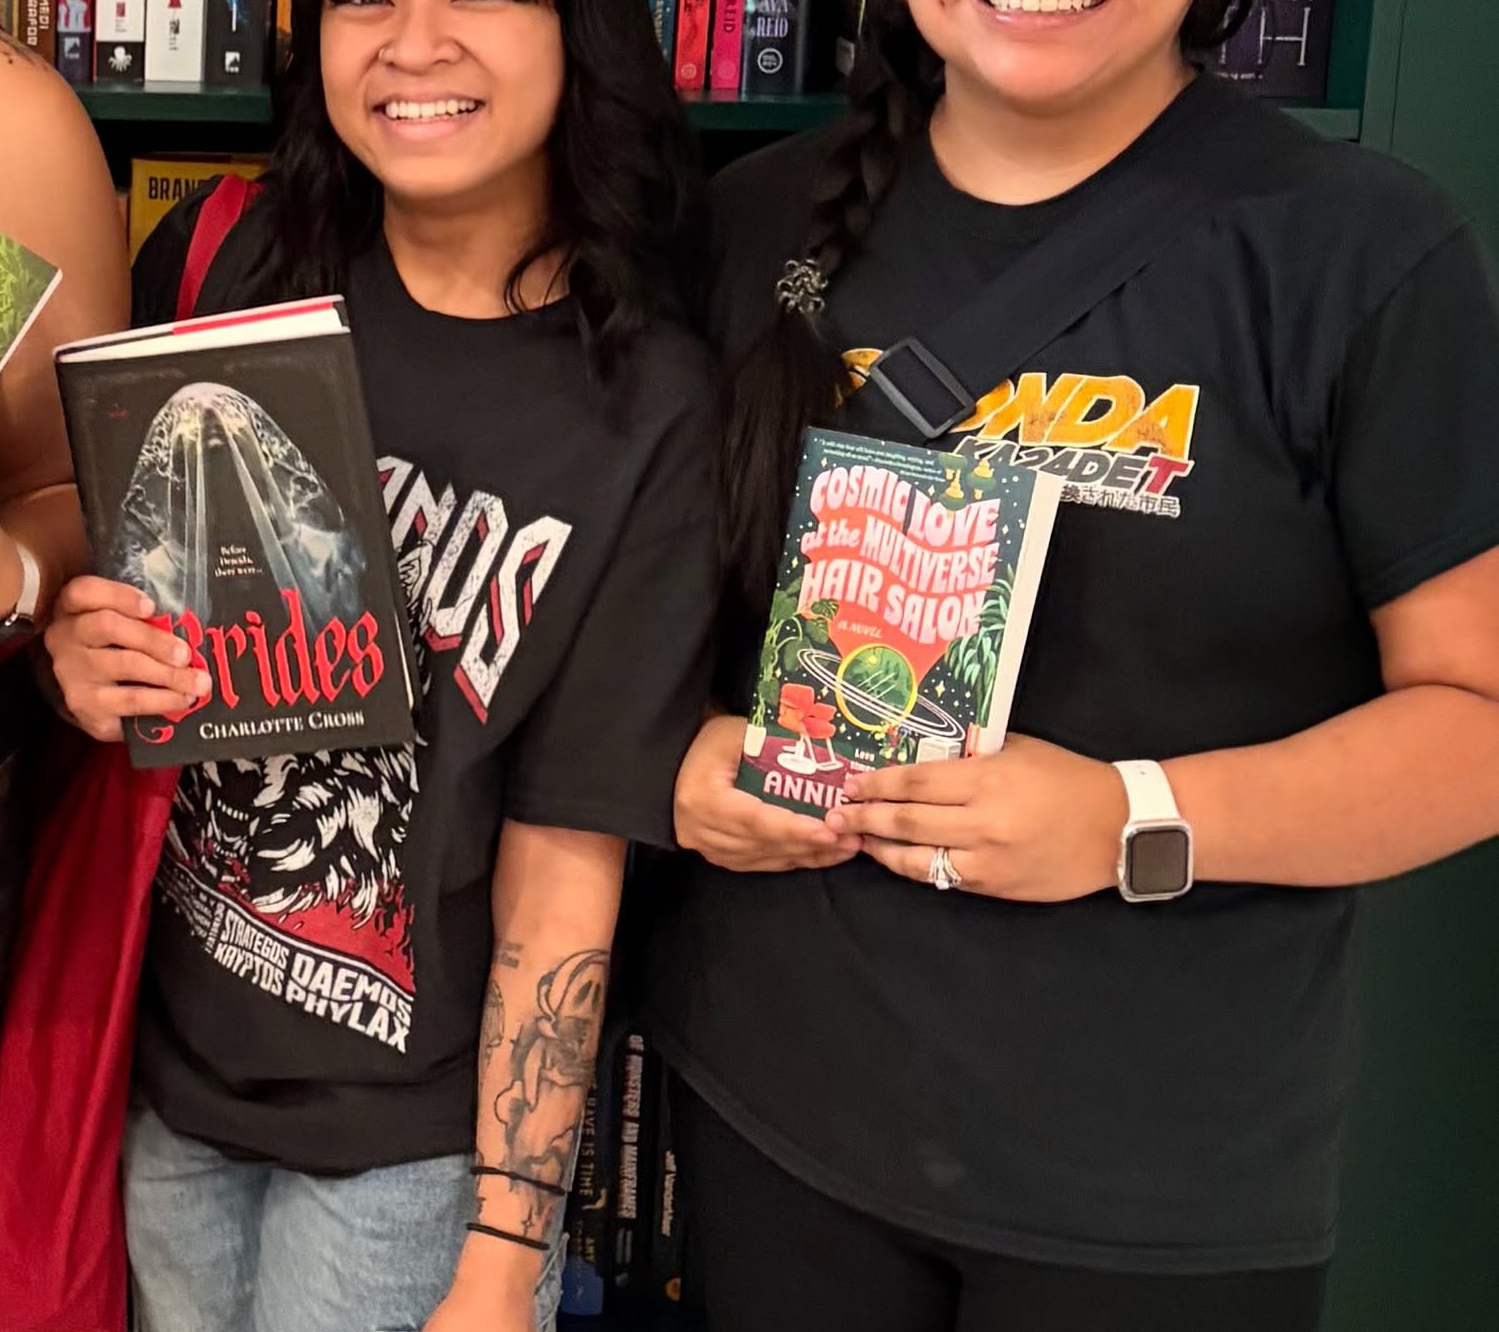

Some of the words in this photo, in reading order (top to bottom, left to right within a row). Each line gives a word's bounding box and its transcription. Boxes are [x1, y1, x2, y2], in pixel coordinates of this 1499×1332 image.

[756, 17, 788, 38] REID
[810, 467, 907, 514] COSMIC
[906, 484, 999, 546] LOVE
[802, 523, 824, 552] at
[828, 519, 859, 548] the
[859, 515, 999, 593] MULTIVERSE
[801, 558, 881, 615] HAIR
[884, 585, 988, 644] SALON
[220, 910, 290, 967] STRATEGOS
[286, 979, 410, 1053] PHYLAX
[291, 954, 411, 1027] DAEMOS
